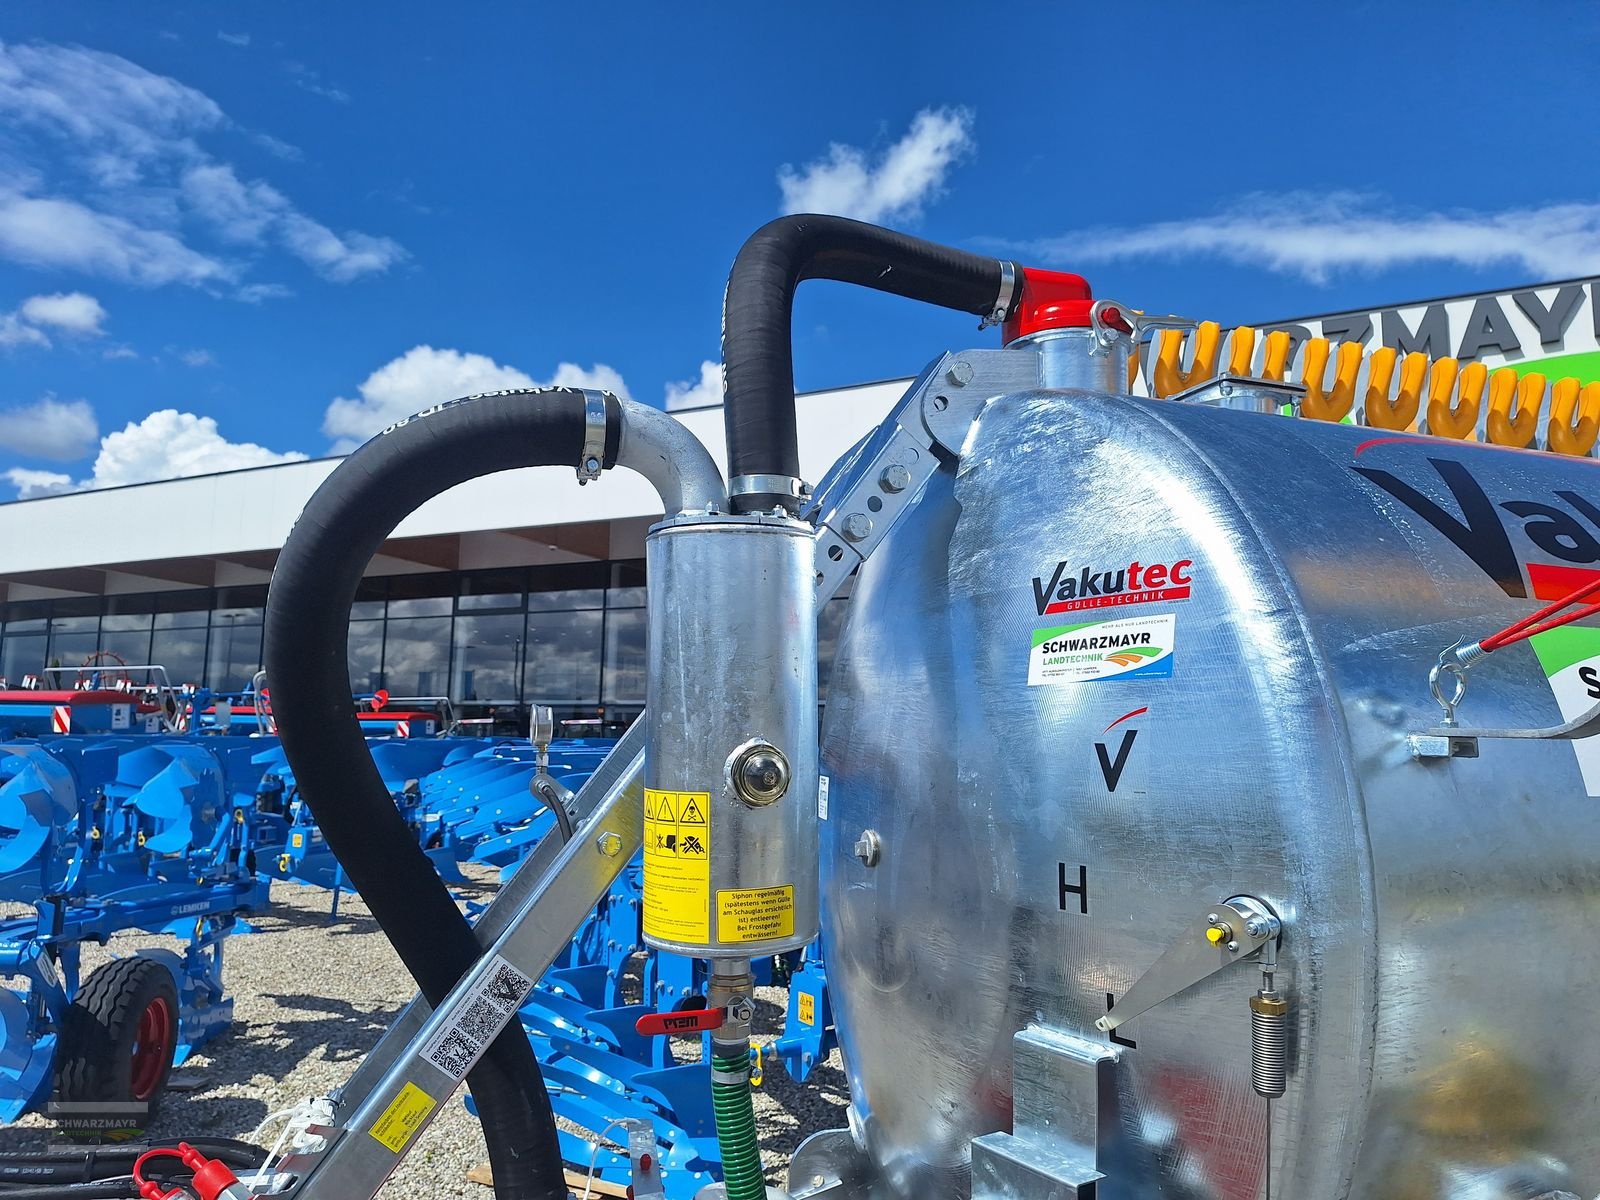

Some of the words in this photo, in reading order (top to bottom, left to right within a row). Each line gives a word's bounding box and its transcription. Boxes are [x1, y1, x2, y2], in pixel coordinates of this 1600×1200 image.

[1032, 560, 1193, 616] Vakutec
[1042, 632, 1151, 654] SCHWARZMAYR
[1042, 653, 1103, 665] LANDTECHNIK
[1058, 862, 1088, 914] H
[179, 901, 210, 914] LEMKEN
[765, 904, 792, 912] ersichtlich
[749, 922, 782, 930] Frostgefahr
[742, 930, 778, 939] entwässern!
